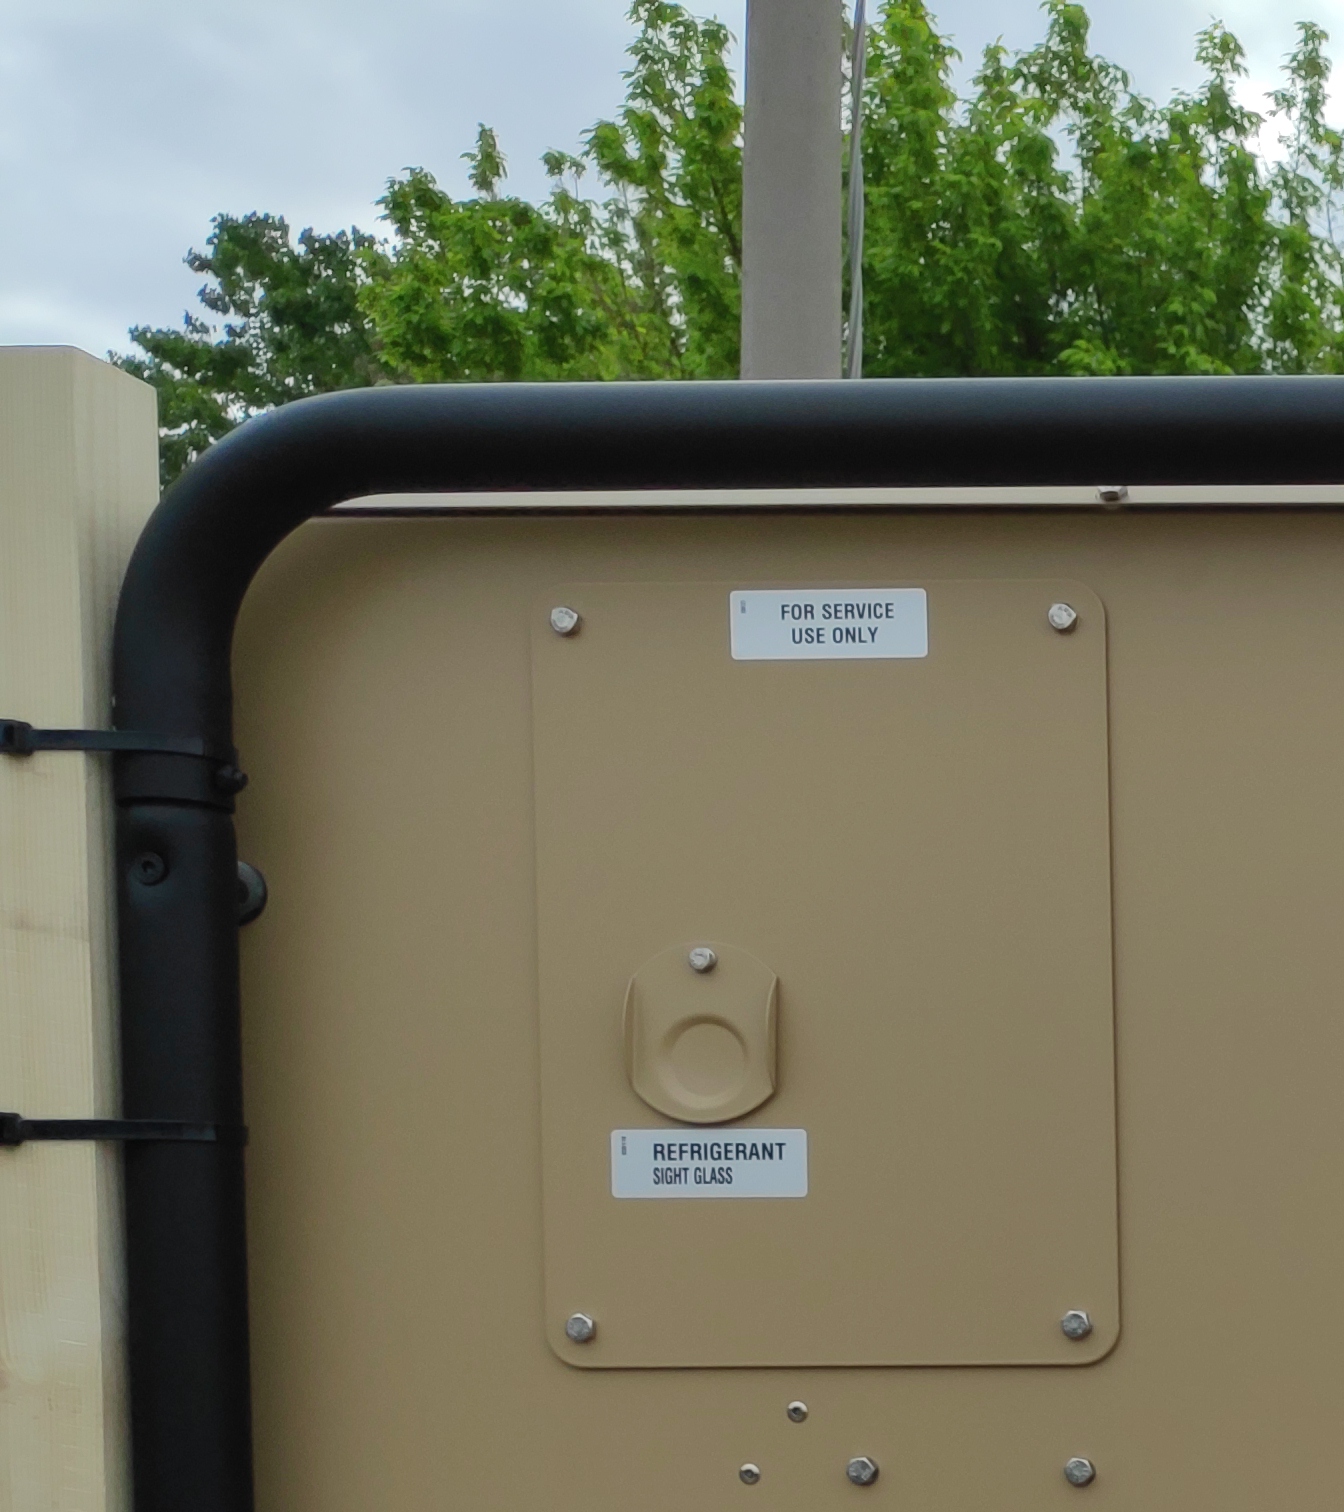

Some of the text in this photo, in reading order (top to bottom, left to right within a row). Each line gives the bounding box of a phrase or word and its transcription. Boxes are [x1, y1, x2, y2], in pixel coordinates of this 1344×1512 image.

[781, 602, 894, 620] FOR SERVICE
[792, 626, 879, 644] USE ONLY
[653, 1143, 786, 1161] REFRIGERANT
[653, 1167, 733, 1185] SIGHT GLASS
